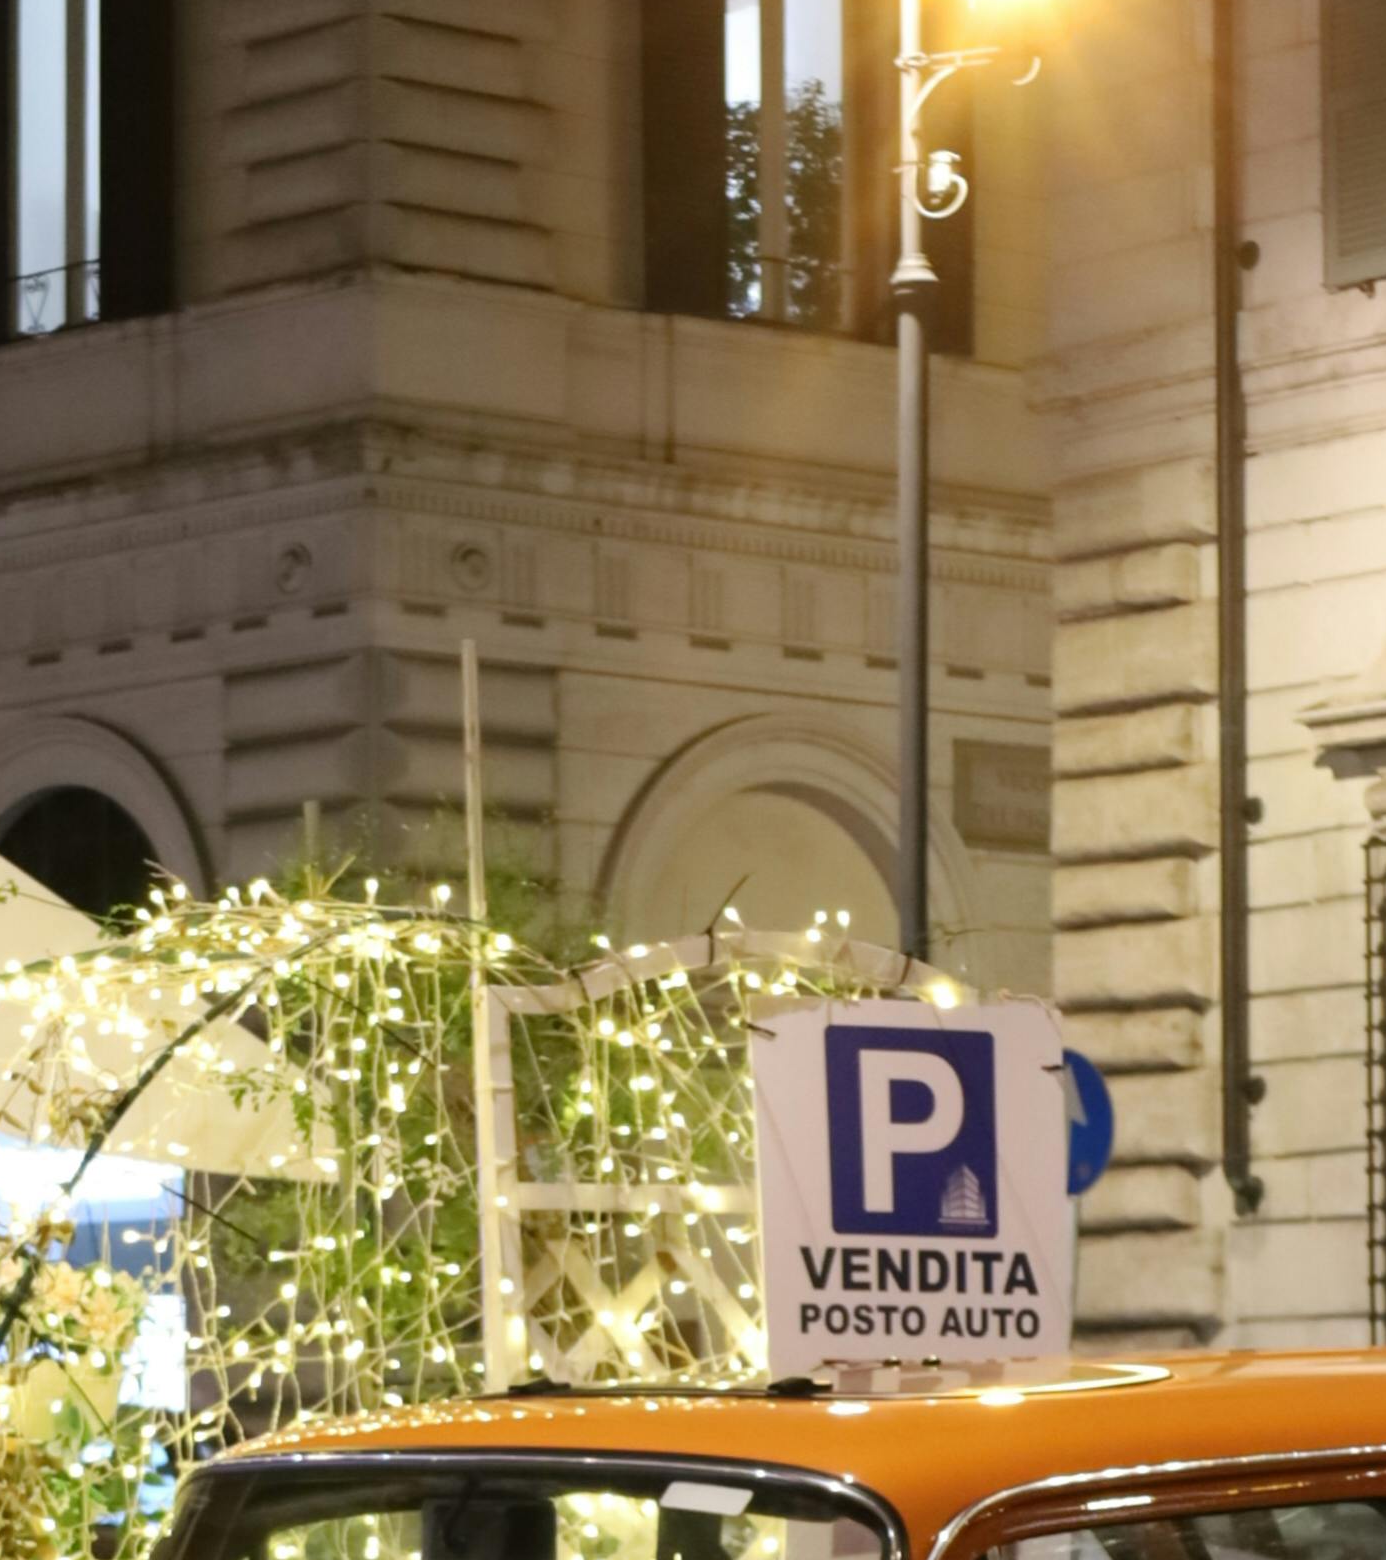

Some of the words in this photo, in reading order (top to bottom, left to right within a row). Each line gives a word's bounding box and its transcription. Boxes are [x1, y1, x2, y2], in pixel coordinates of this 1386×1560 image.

[857, 1048, 965, 1214] P
[799, 1245, 1039, 1297] VENDITA
[800, 1303, 926, 1337] POSTO
[940, 1308, 1040, 1340] AUTO
